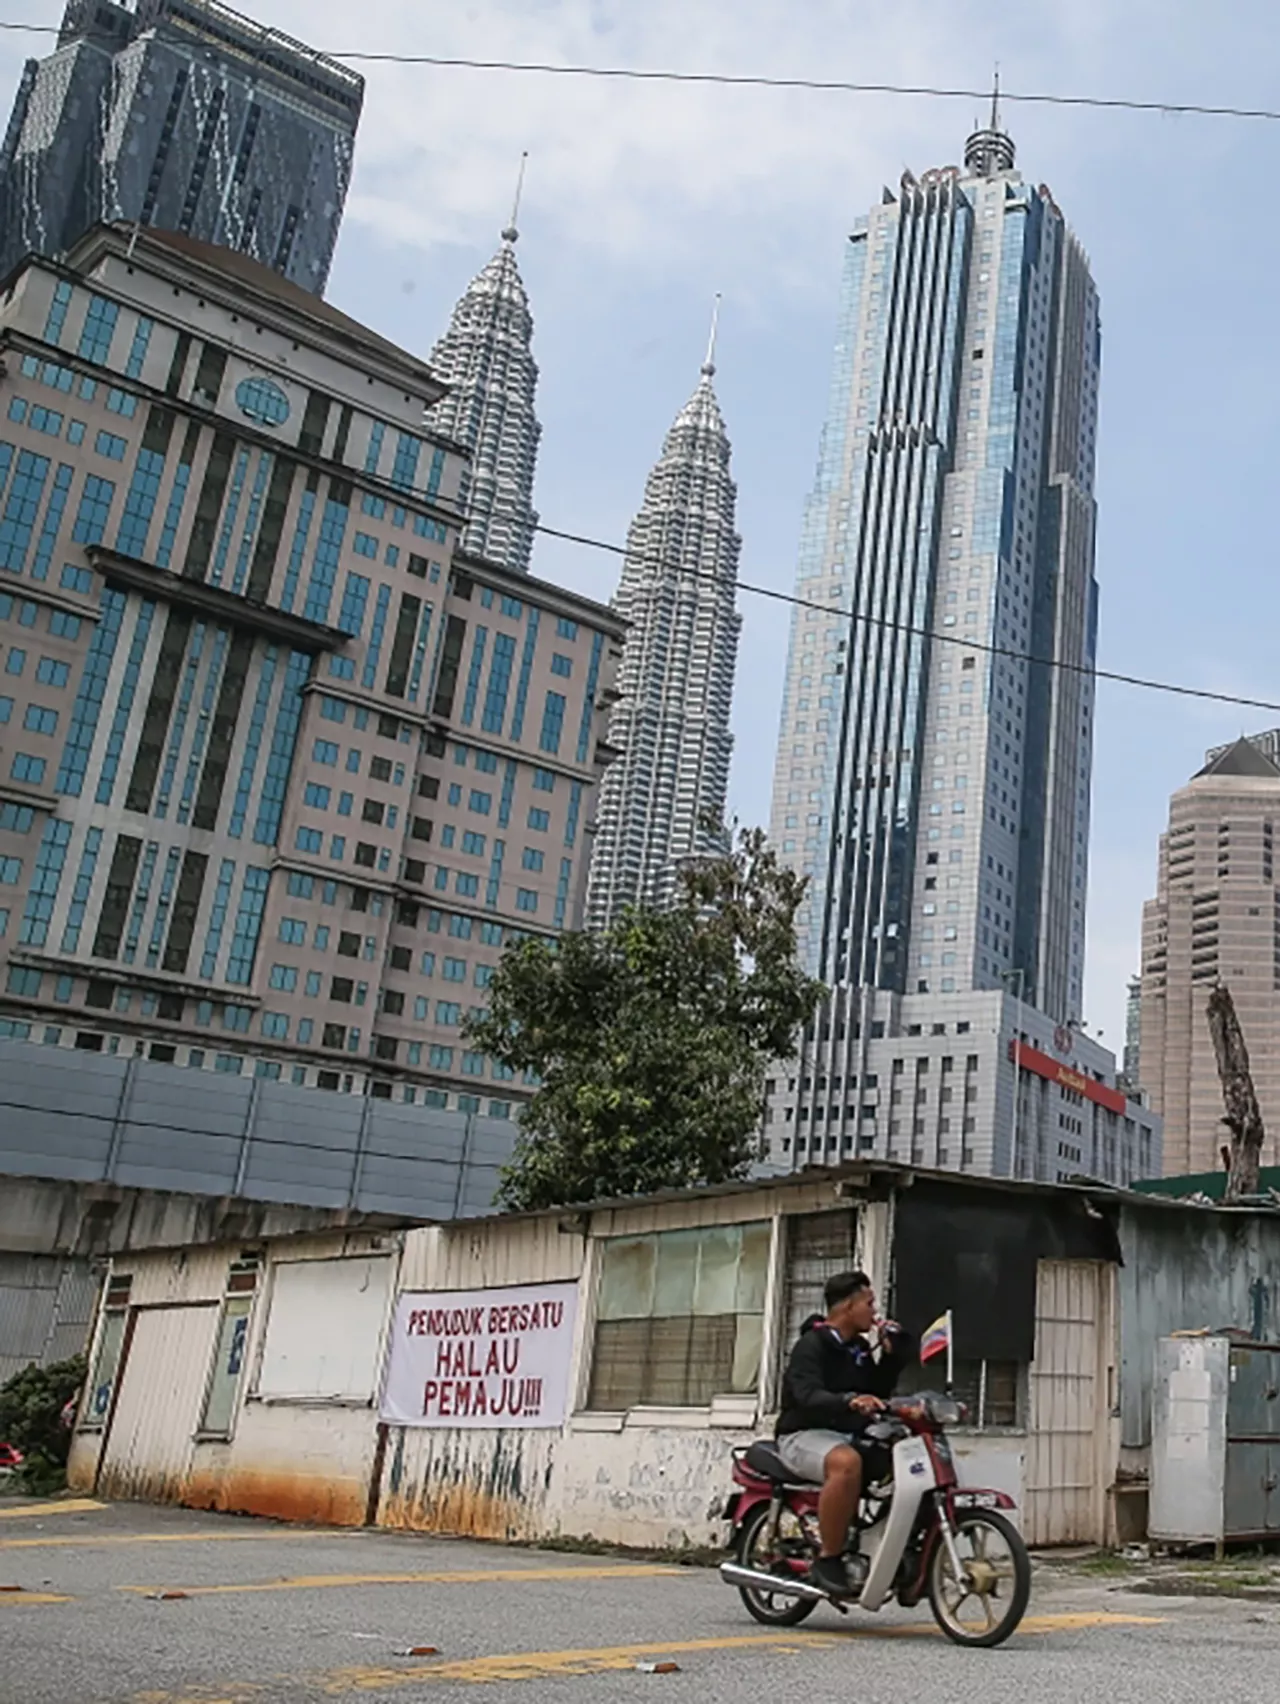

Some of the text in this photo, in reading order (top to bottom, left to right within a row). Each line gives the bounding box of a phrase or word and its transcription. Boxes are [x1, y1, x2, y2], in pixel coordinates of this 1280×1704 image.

[408, 1301, 563, 1336] PENDUDUK BERSATU
[435, 1337, 520, 1377] HALAU
[422, 1378, 543, 1417] PEMAJU!!!
